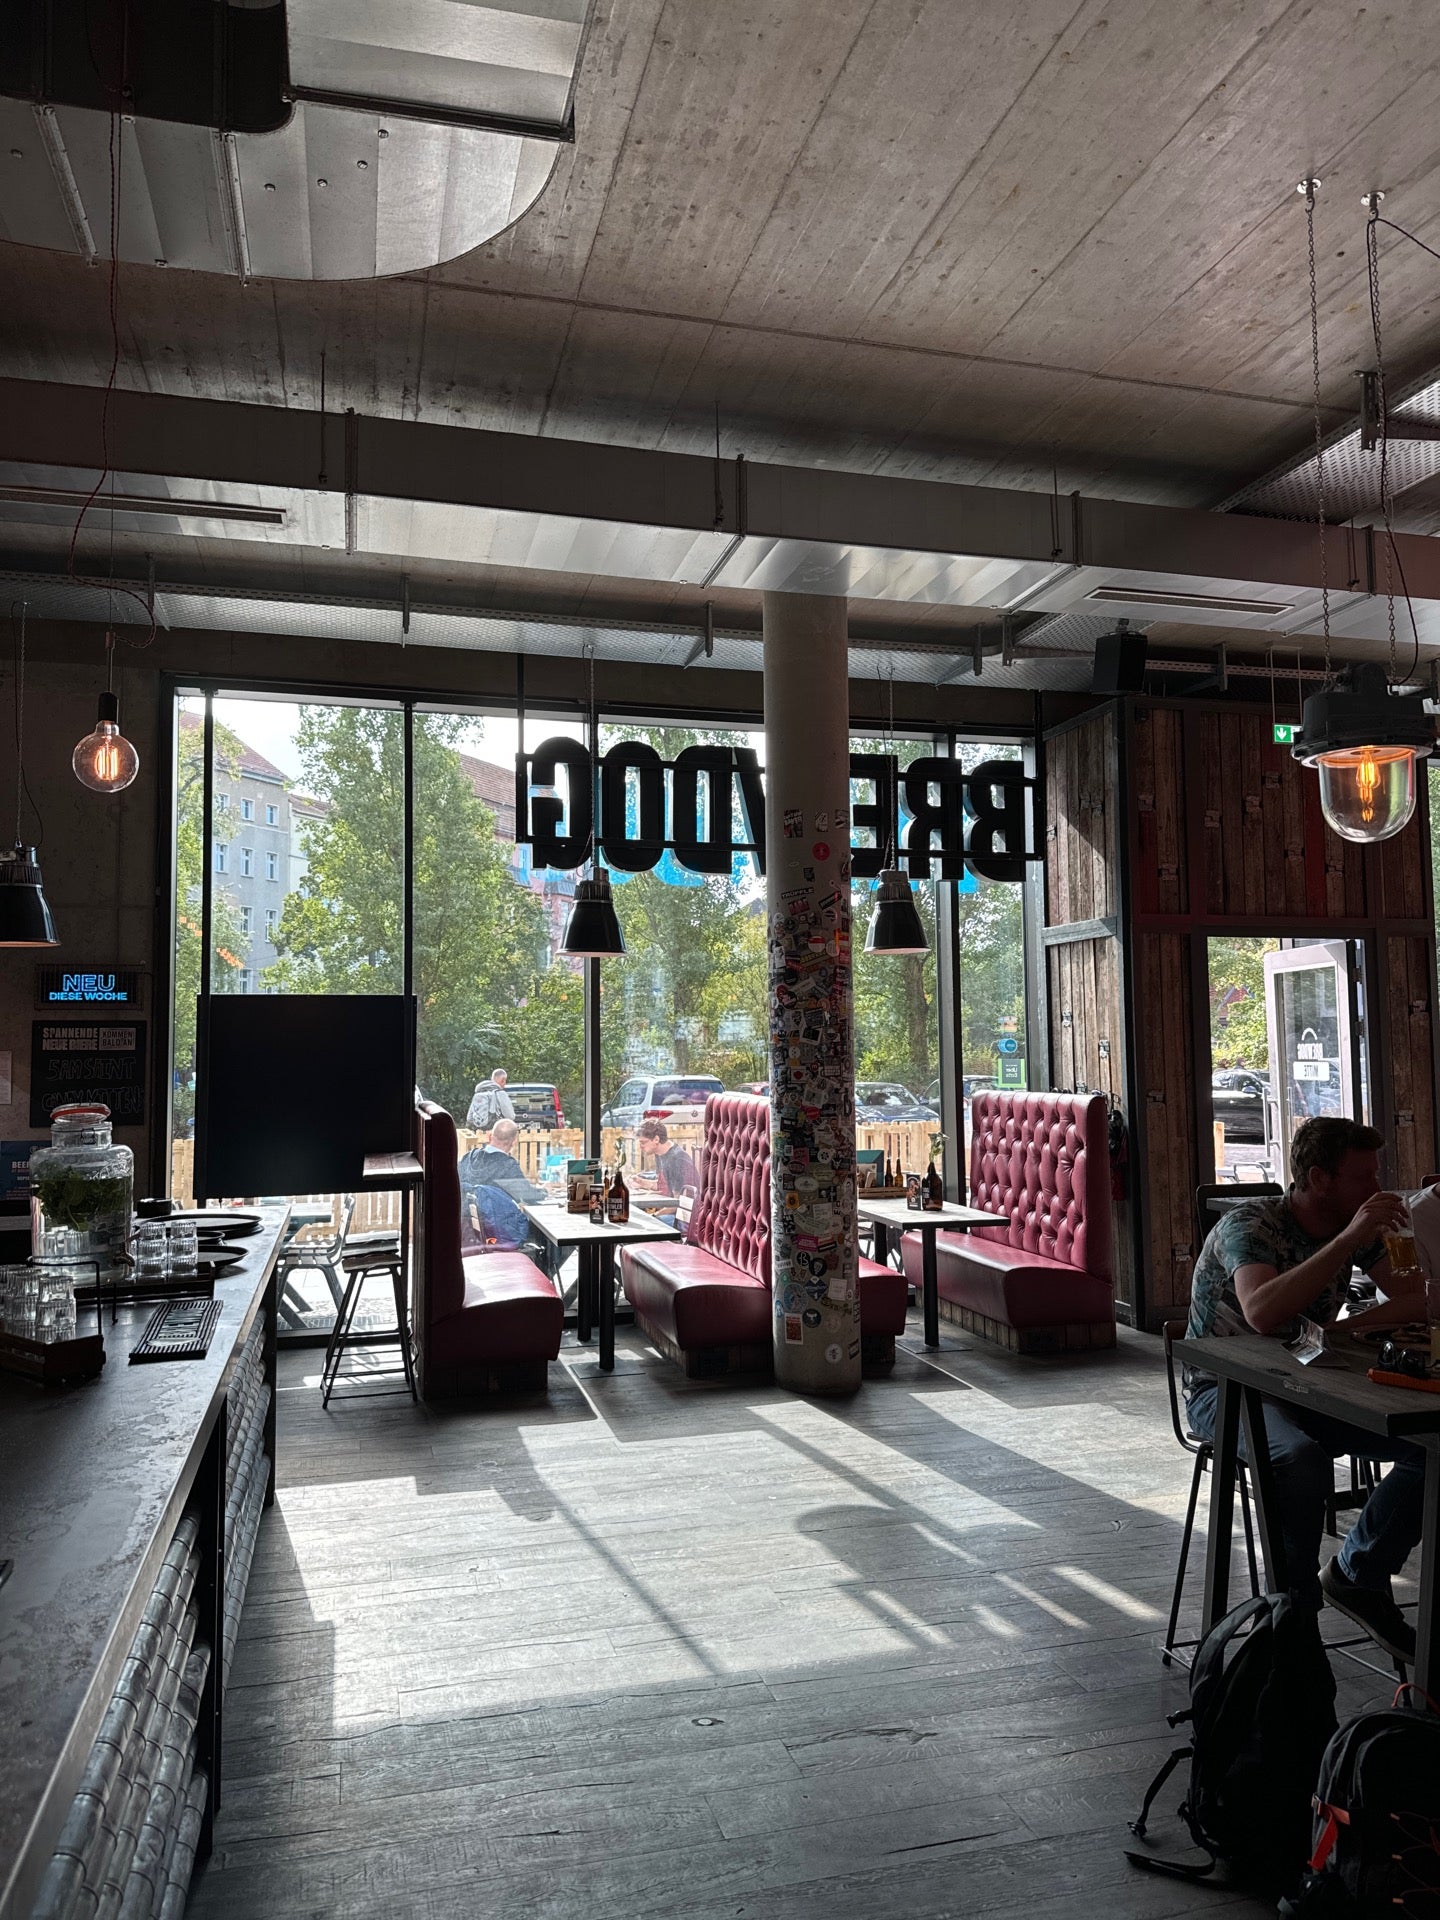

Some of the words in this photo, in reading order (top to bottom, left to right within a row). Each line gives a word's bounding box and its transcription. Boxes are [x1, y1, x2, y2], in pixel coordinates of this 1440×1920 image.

[62, 974, 115, 992] NEU
[49, 992, 83, 1001] DIESE
[84, 992, 128, 1001] WOCHE
[42, 1027, 98, 1039] SPANNENDE
[42, 1039, 69, 1051] NEUE
[69, 1039, 98, 1051] BIERE
[102, 1039, 121, 1047] BALD
[123, 1039, 132, 1047] AN
